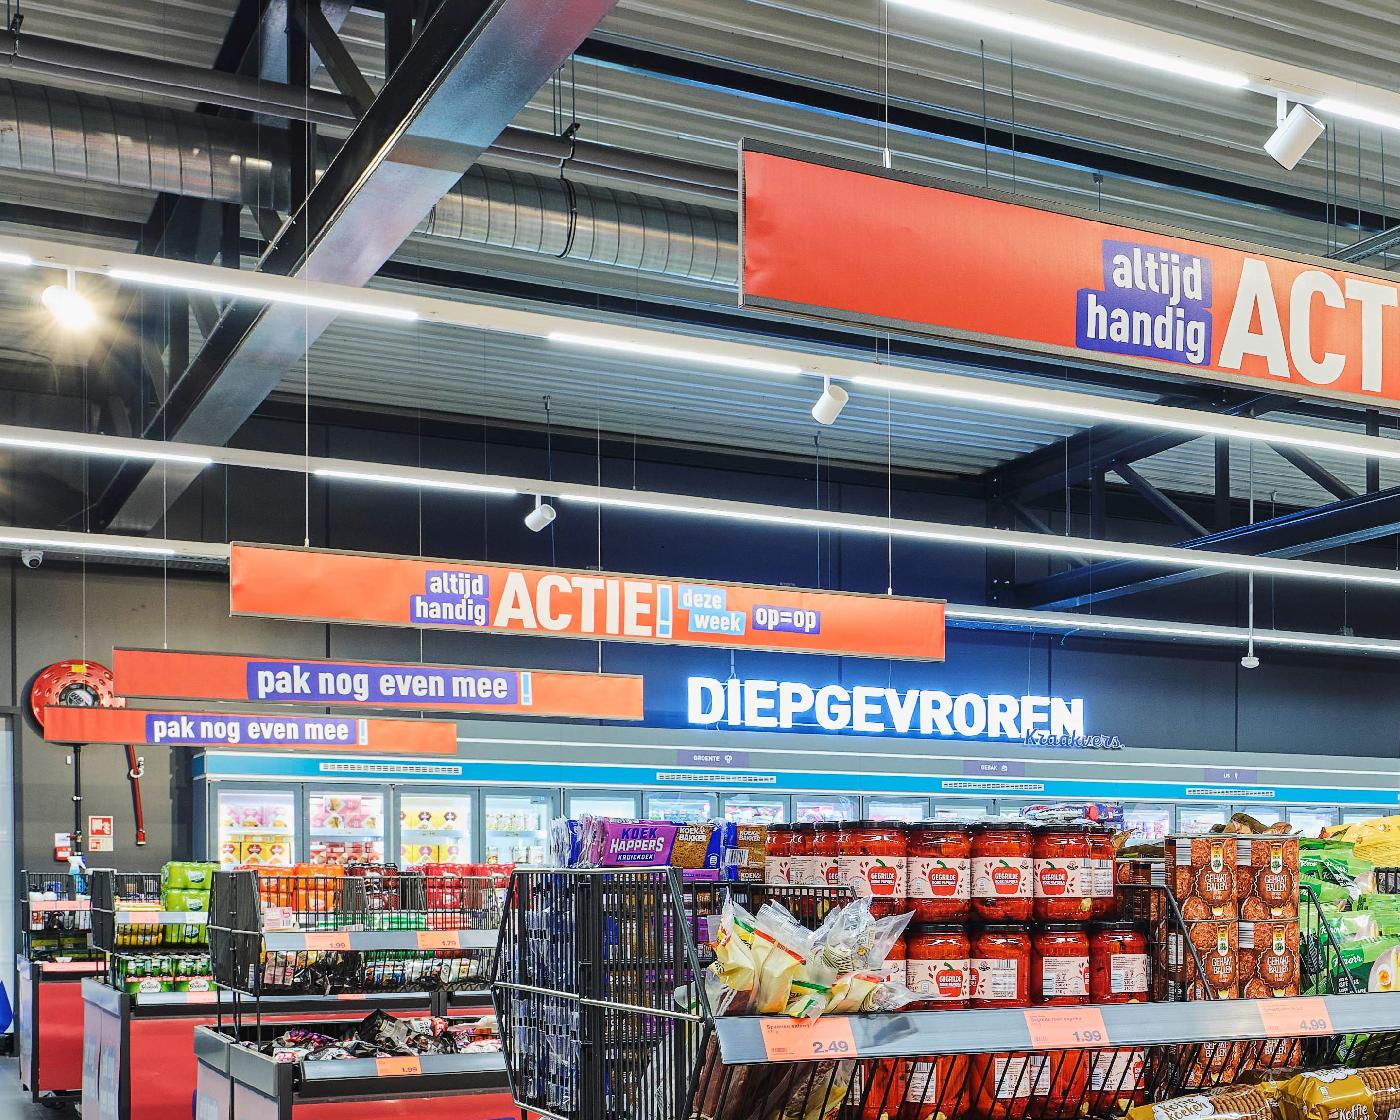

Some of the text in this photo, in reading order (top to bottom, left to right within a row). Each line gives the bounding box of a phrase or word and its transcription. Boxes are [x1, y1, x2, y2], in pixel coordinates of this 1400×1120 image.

[1112, 248, 1203, 305] altijd
[1087, 295, 1206, 364] handig
[430, 572, 484, 599] altijd
[682, 588, 722, 609] deze
[415, 596, 486, 626] handig
[493, 571, 673, 638] ACTIE!
[693, 612, 741, 632] week
[755, 607, 816, 633] op=op
[257, 665, 312, 699] pak
[318, 671, 369, 702] nog
[379, 673, 446, 698] even
[687, 676, 1085, 741] DIEPGEVROREN
[153, 716, 195, 743] pak
[200, 721, 241, 744] nog
[248, 722, 299, 741] even
[610, 837, 664, 853] HAPPERS
[621, 827, 657, 839] KOEK
[1072, 1030, 1102, 1042] 1.99
[1300, 1019, 1327, 1031] 4.99
[812, 1041, 849, 1053] 2.49
[1339, 1105, 1368, 1120] Koffie
